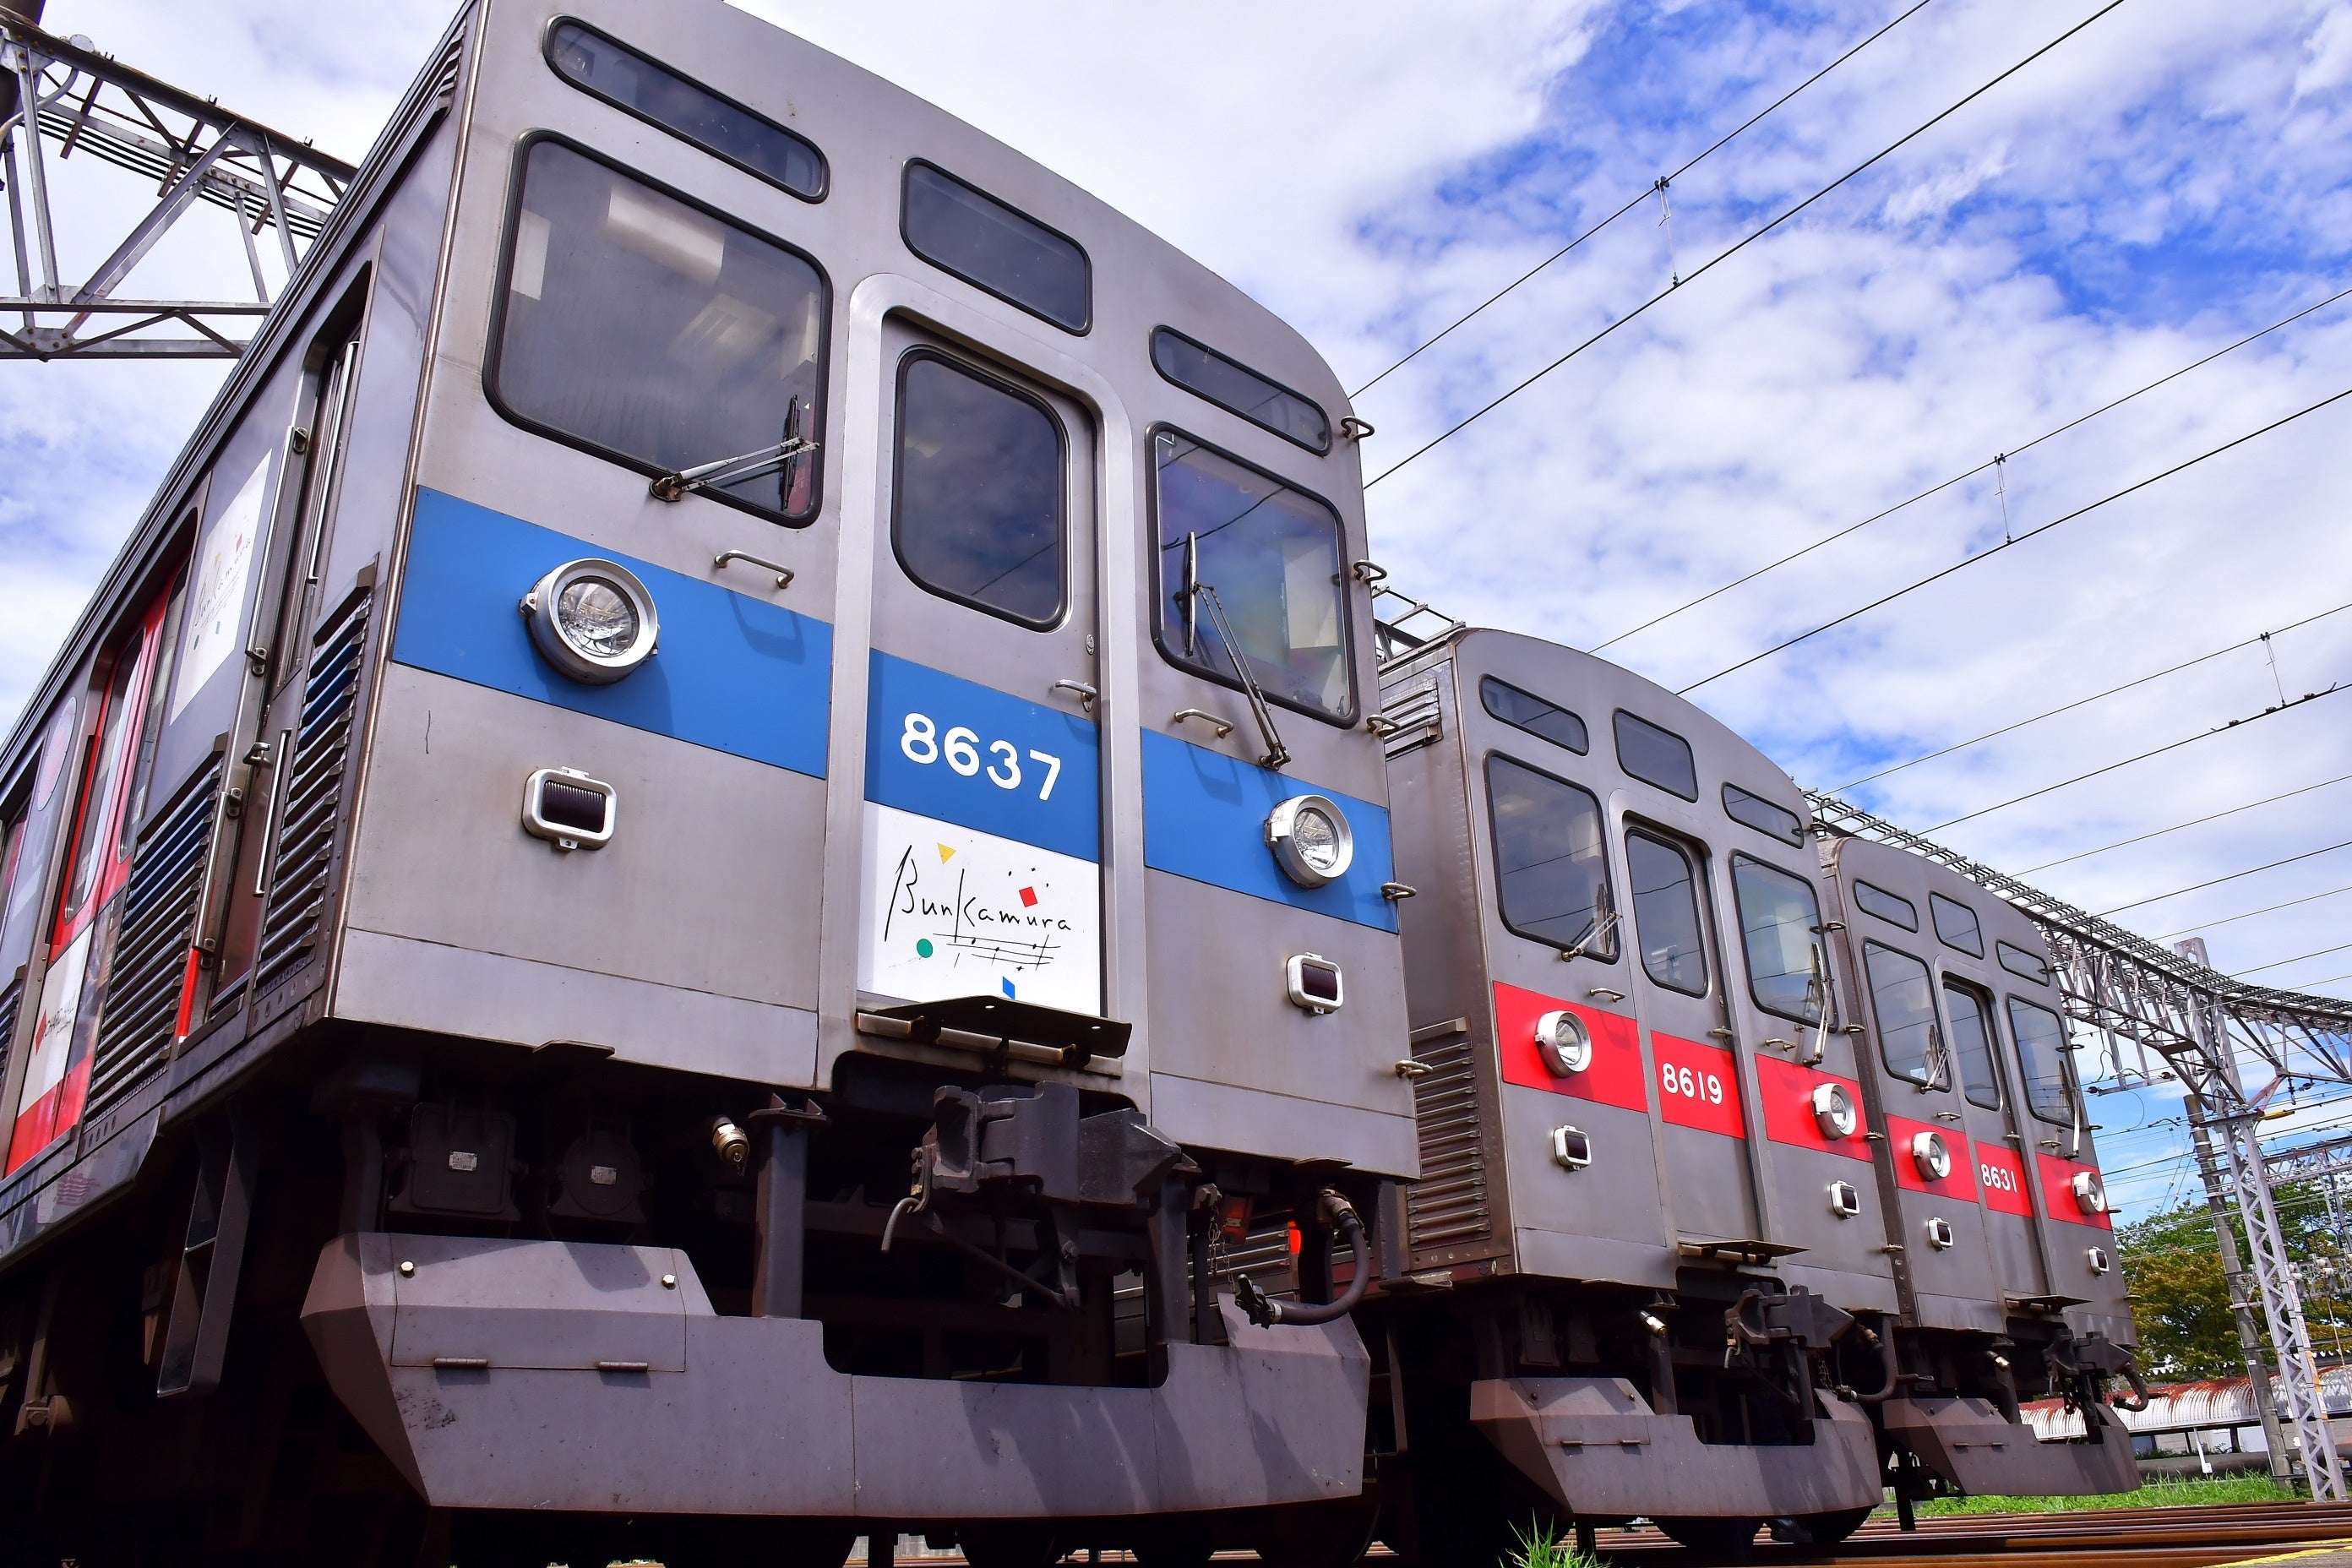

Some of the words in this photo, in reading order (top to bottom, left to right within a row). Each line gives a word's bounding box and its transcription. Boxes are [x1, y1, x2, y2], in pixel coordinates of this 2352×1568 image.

[901, 712, 1061, 801] 8637
[1663, 1062, 1723, 1105] 8619
[1980, 1163, 2017, 1193] 8631
